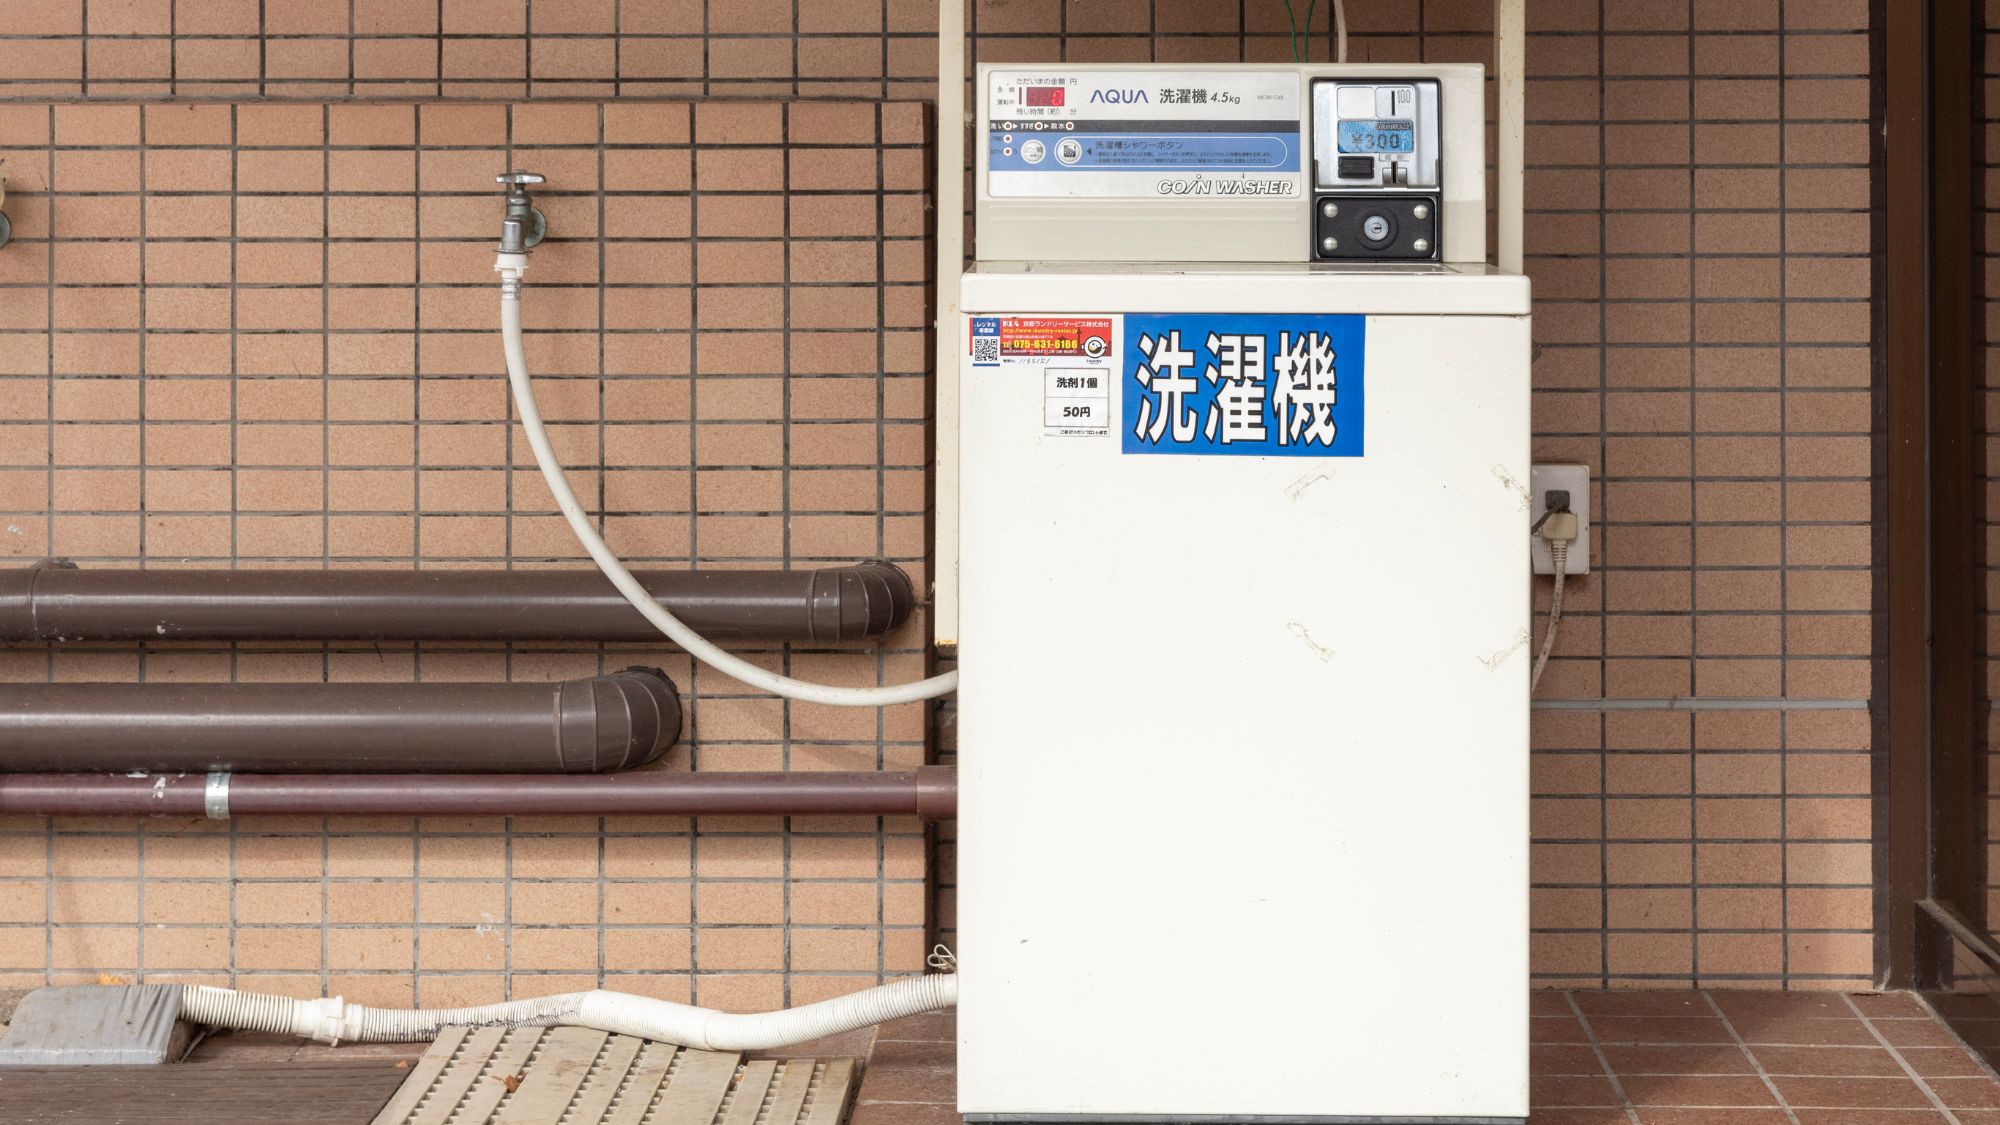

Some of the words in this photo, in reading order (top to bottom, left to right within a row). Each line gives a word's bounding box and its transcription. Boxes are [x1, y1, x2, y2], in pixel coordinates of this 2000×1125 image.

[1090, 89, 1149, 104] AQUA
[1159, 88, 1208, 104] 洗濯機
[1210, 91, 1241, 104] 4.5kg
[1397, 89, 1411, 104] 100
[1351, 132, 1400, 150] ¥300
[1157, 179, 1211, 195] COIN
[1215, 179, 1293, 195] WASHER
[1056, 377, 1098, 388] 洗剤1個
[1133, 329, 1337, 447] 洗濯機
[1063, 406, 1091, 417] 50円
